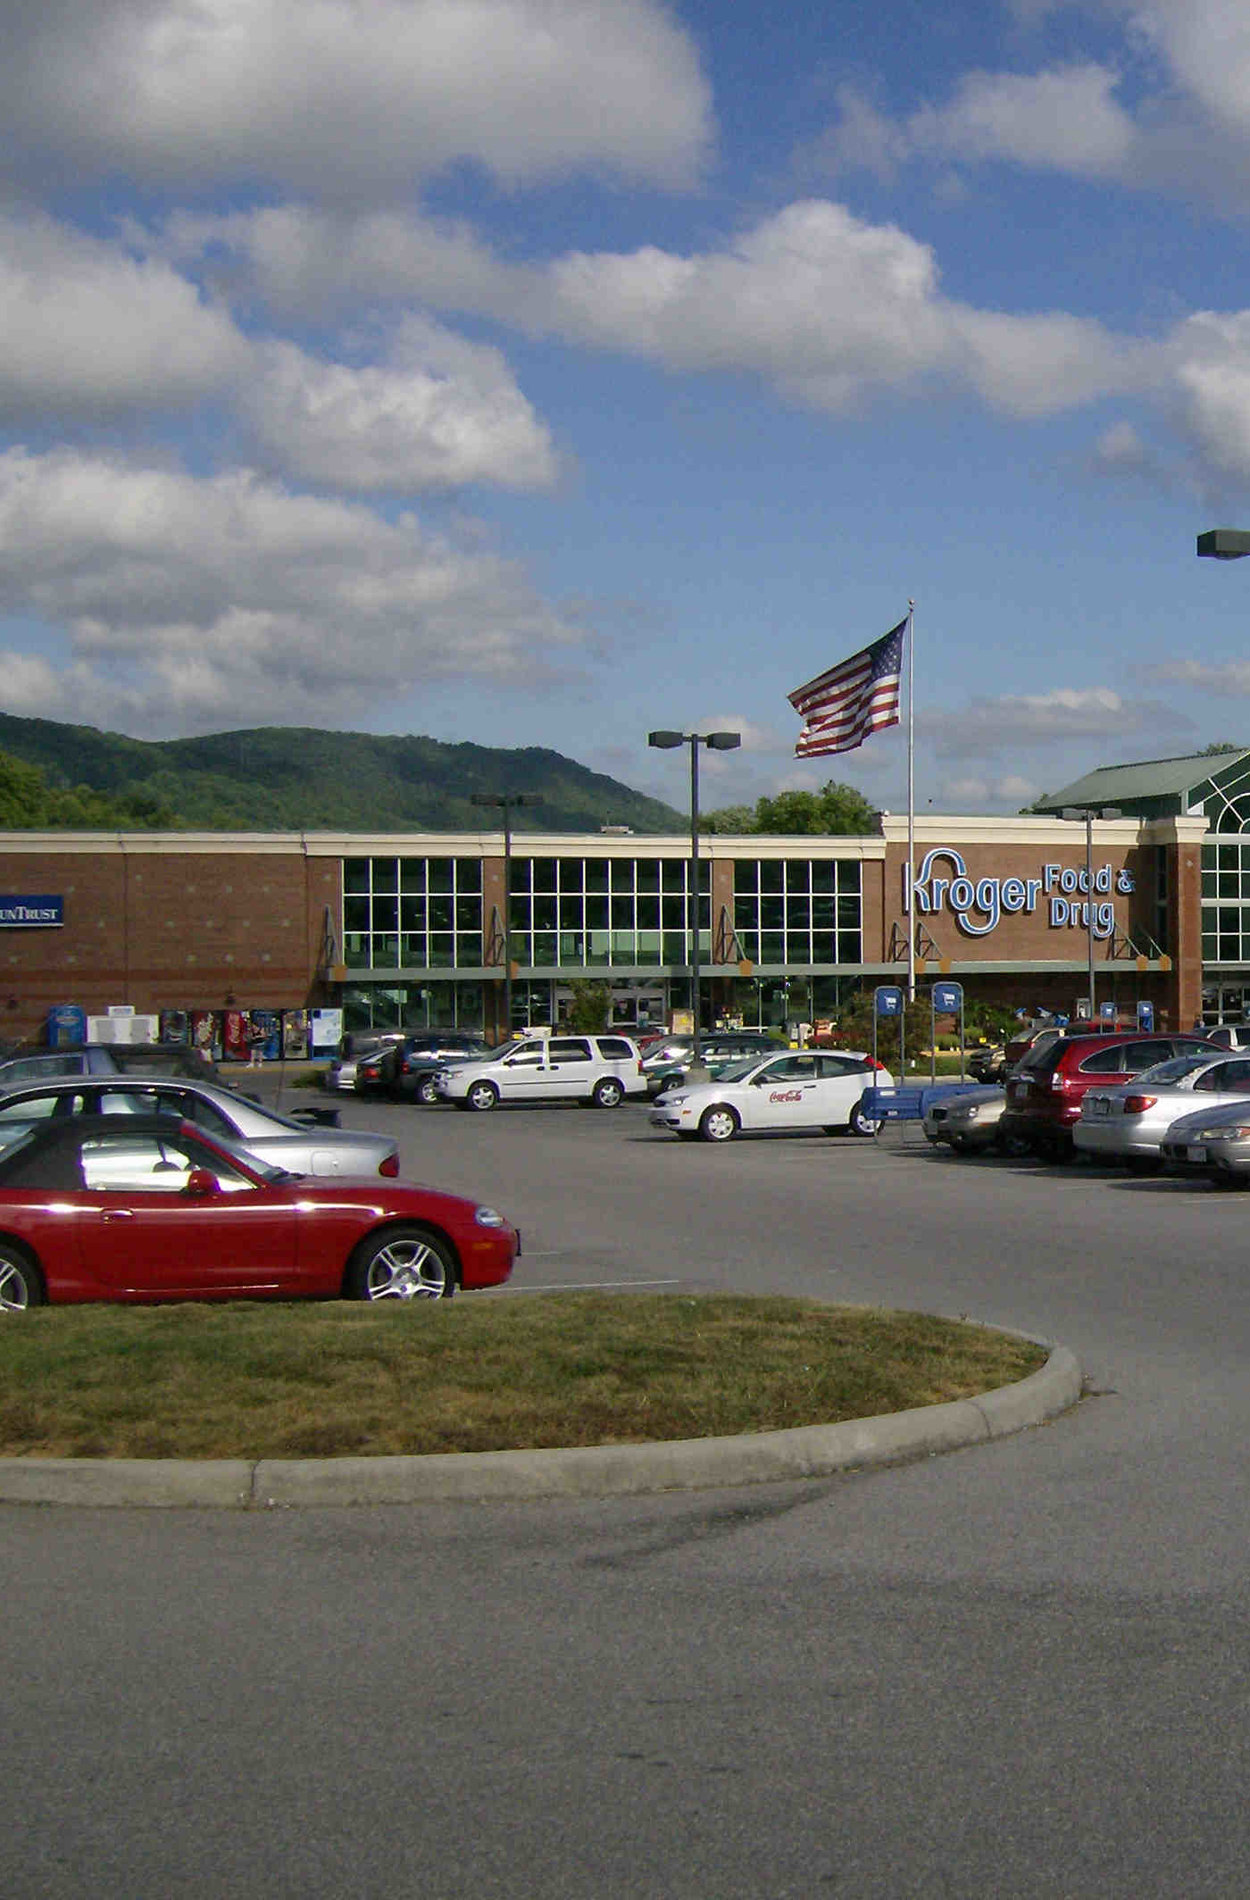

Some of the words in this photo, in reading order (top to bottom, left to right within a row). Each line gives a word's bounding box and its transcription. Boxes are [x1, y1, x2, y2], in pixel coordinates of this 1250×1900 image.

[905, 847, 1042, 935] Kroger
[1045, 864, 1112, 894] Food
[1117, 869, 1135, 893] &
[1051, 897, 1115, 938] Drug
